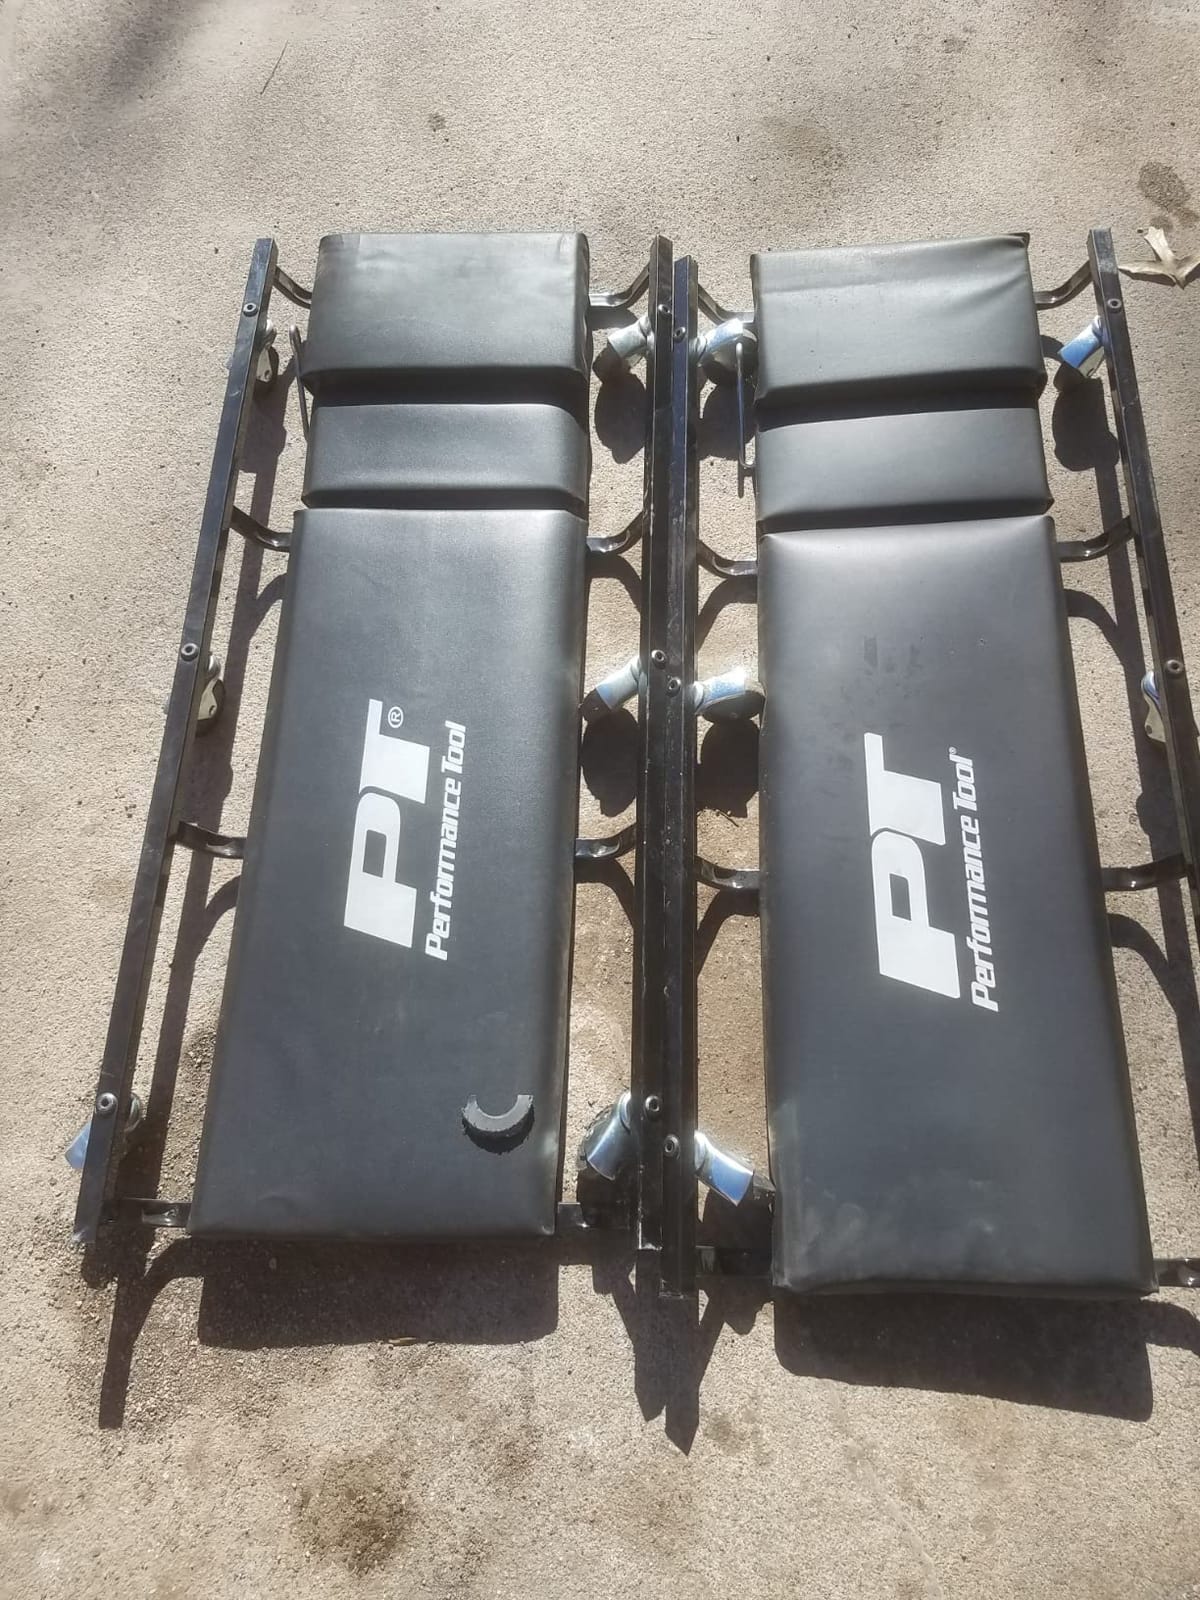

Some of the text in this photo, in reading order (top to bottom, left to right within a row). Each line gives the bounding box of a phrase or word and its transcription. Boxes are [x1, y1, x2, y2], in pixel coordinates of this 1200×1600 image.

[343, 698, 431, 949] PT
[424, 719, 467, 961] Performance Tool
[863, 731, 961, 1000] PT
[949, 754, 999, 1013] Performance Tool
